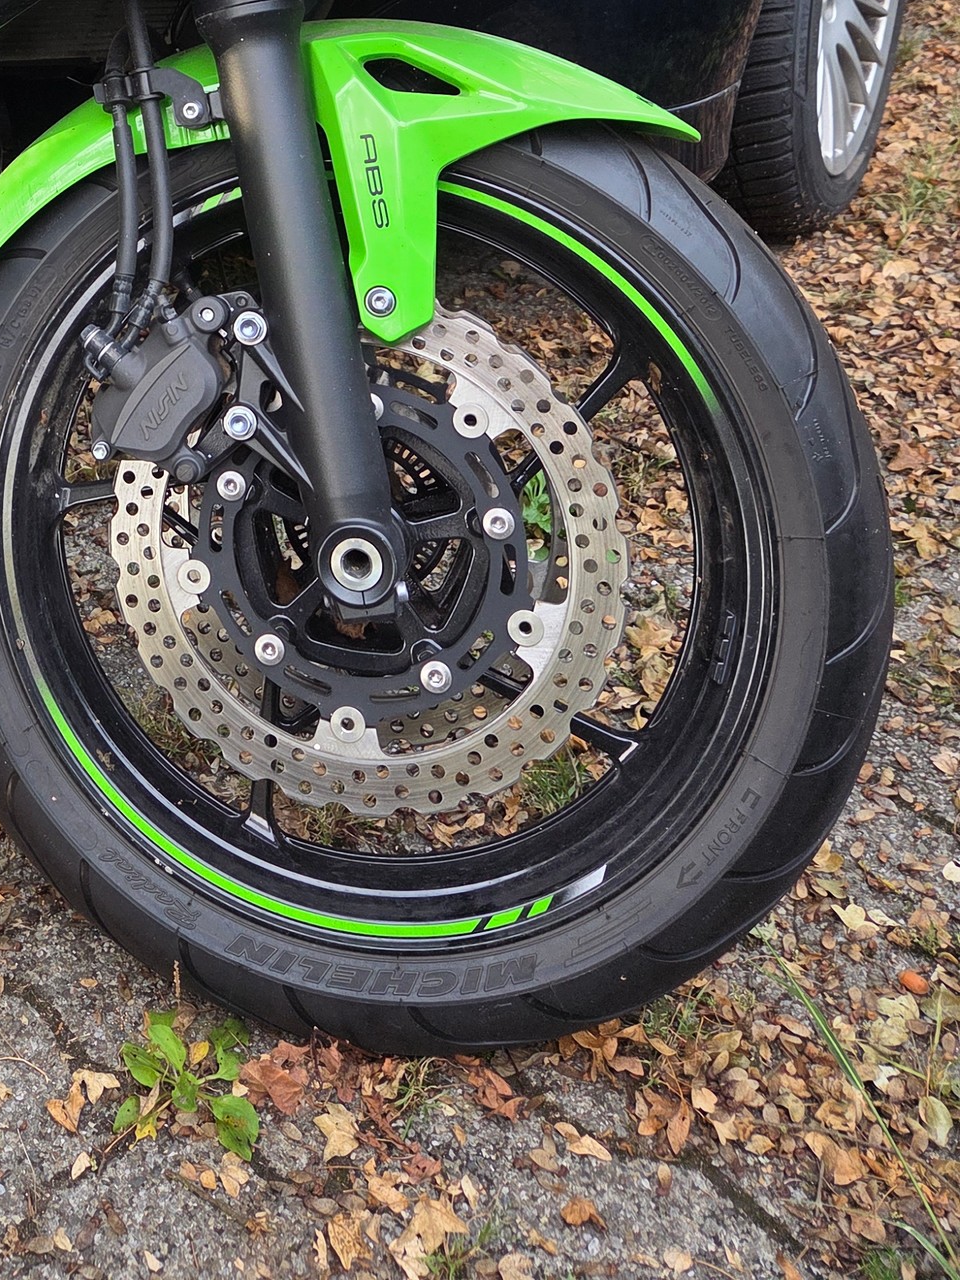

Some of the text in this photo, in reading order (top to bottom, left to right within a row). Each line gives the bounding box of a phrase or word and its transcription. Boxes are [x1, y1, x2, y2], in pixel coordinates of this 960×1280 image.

[359, 133, 390, 229] ABS
[704, 805, 751, 869] FRONT
[97, 845, 198, 931] Radial
[225, 933, 538, 998] MICHELIN
